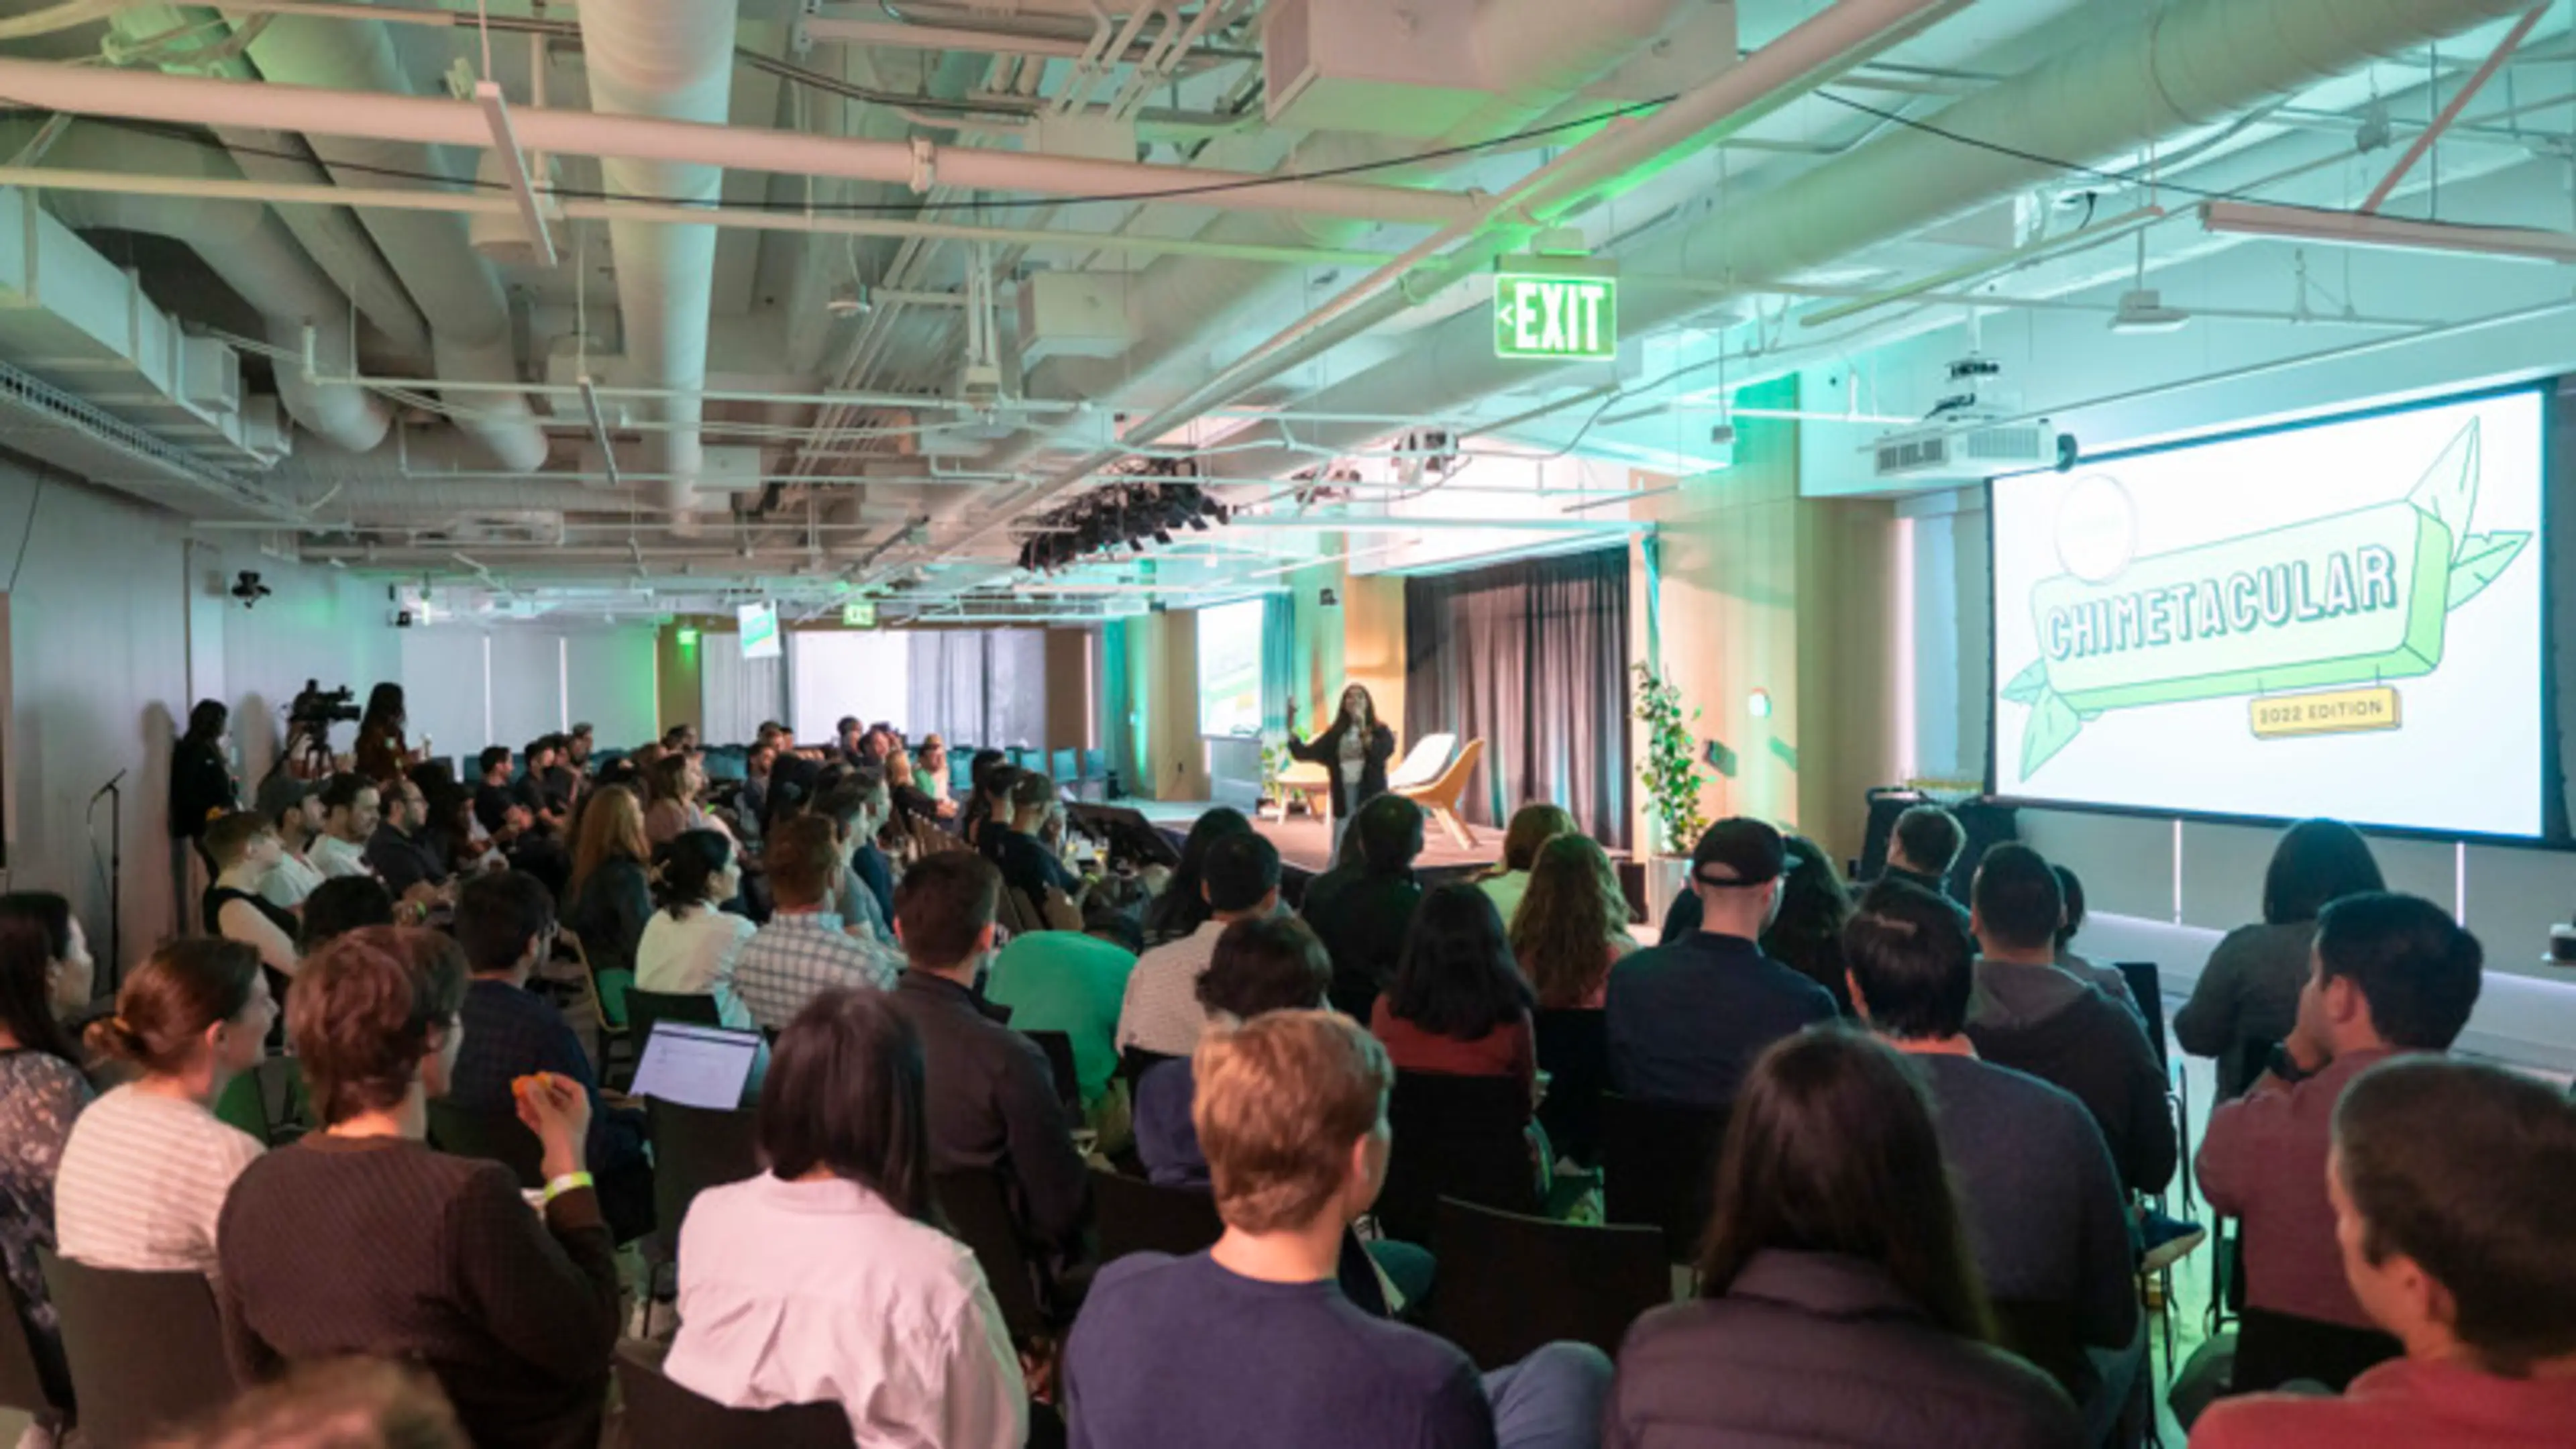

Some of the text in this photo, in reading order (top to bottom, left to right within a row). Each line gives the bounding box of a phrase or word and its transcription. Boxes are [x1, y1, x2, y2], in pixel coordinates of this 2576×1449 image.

[1515, 282, 1605, 352] EXIT
[2045, 544, 2398, 661] CHIMETACULAR
[2259, 700, 2383, 724] 2022 EDITION
